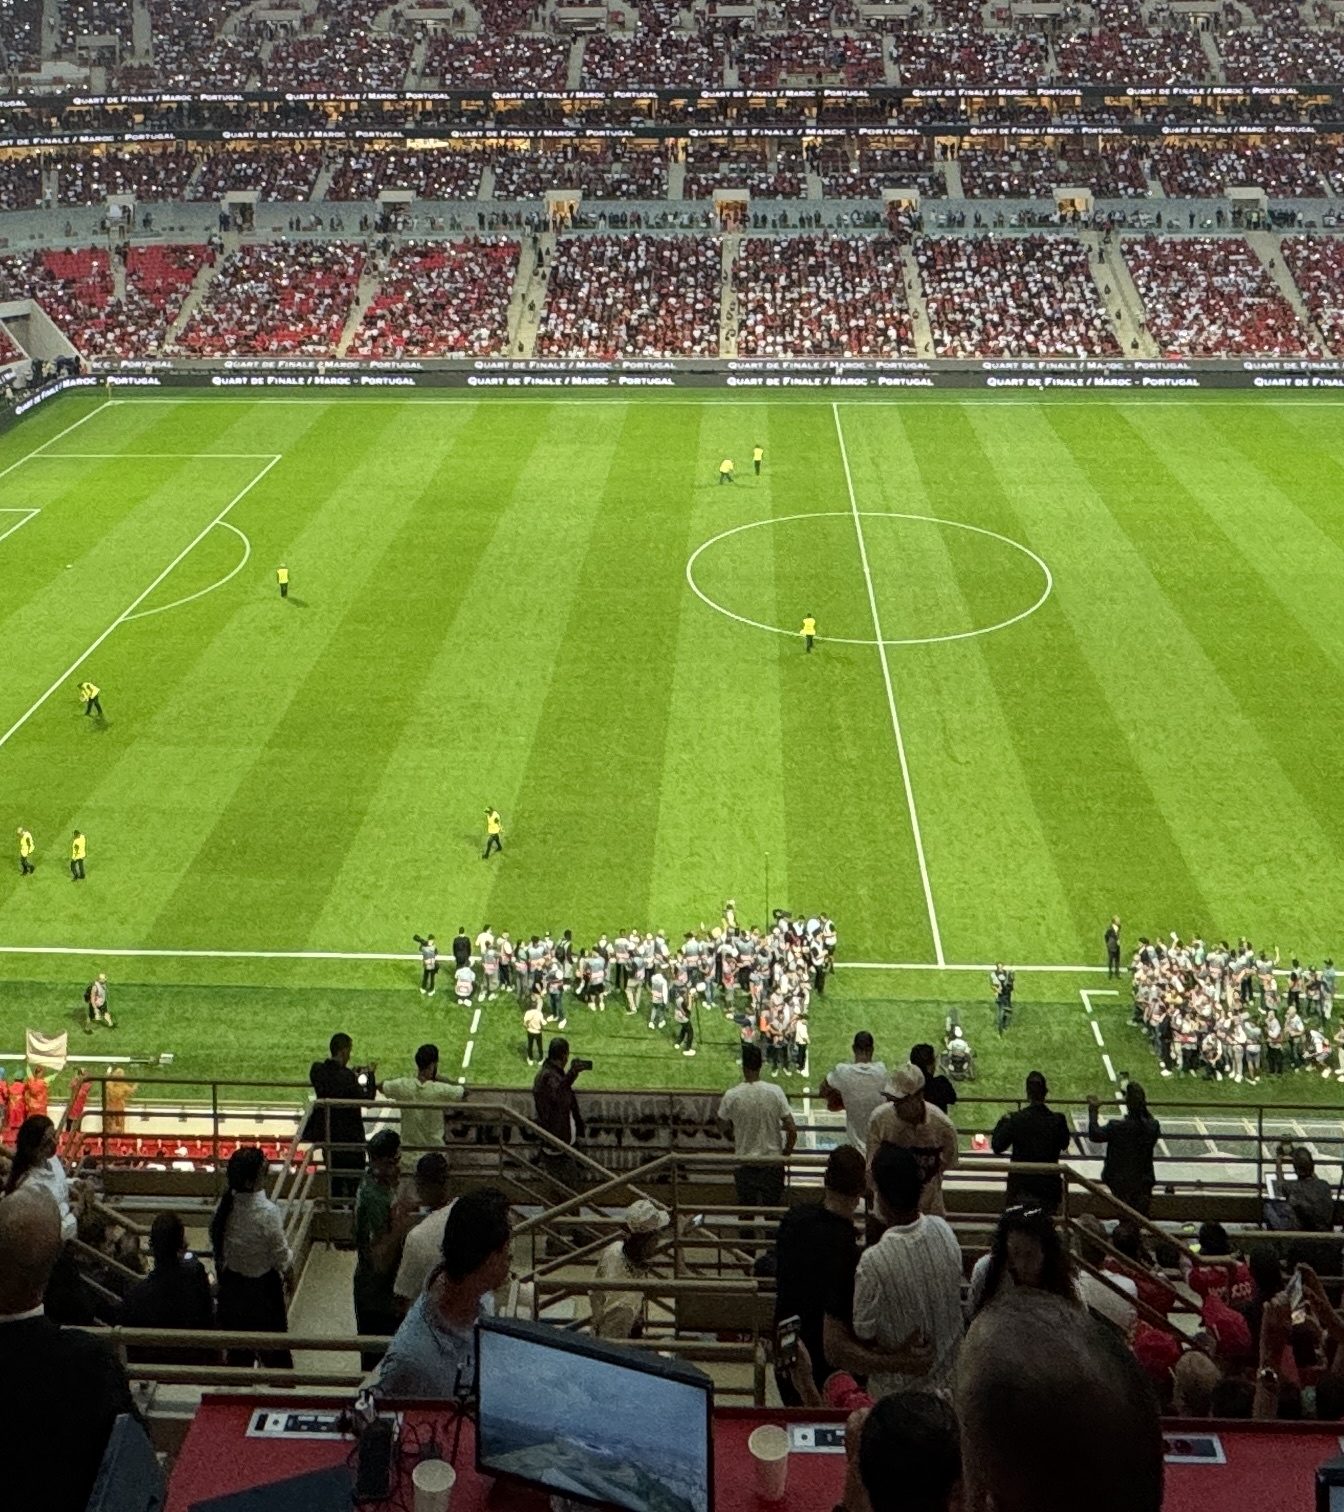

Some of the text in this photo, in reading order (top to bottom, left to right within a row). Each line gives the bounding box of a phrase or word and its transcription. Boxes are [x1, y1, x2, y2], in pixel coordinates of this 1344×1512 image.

[212, 377, 248, 386] QUART
[267, 377, 304, 385] FINALE
[314, 376, 350, 385] MAROC
[362, 376, 416, 385] PORTUGAL
[468, 377, 504, 385] QUART
[524, 377, 562, 385] FINALE
[572, 377, 608, 385] MAROC
[620, 376, 674, 385] PORTUGAL
[727, 377, 932, 386] QUART DE FINALE MAROC PORTUGAL
[987, 377, 1200, 386] QUART DE FINALE MAROC PORTUGAL
[1254, 378, 1292, 386] QUART
